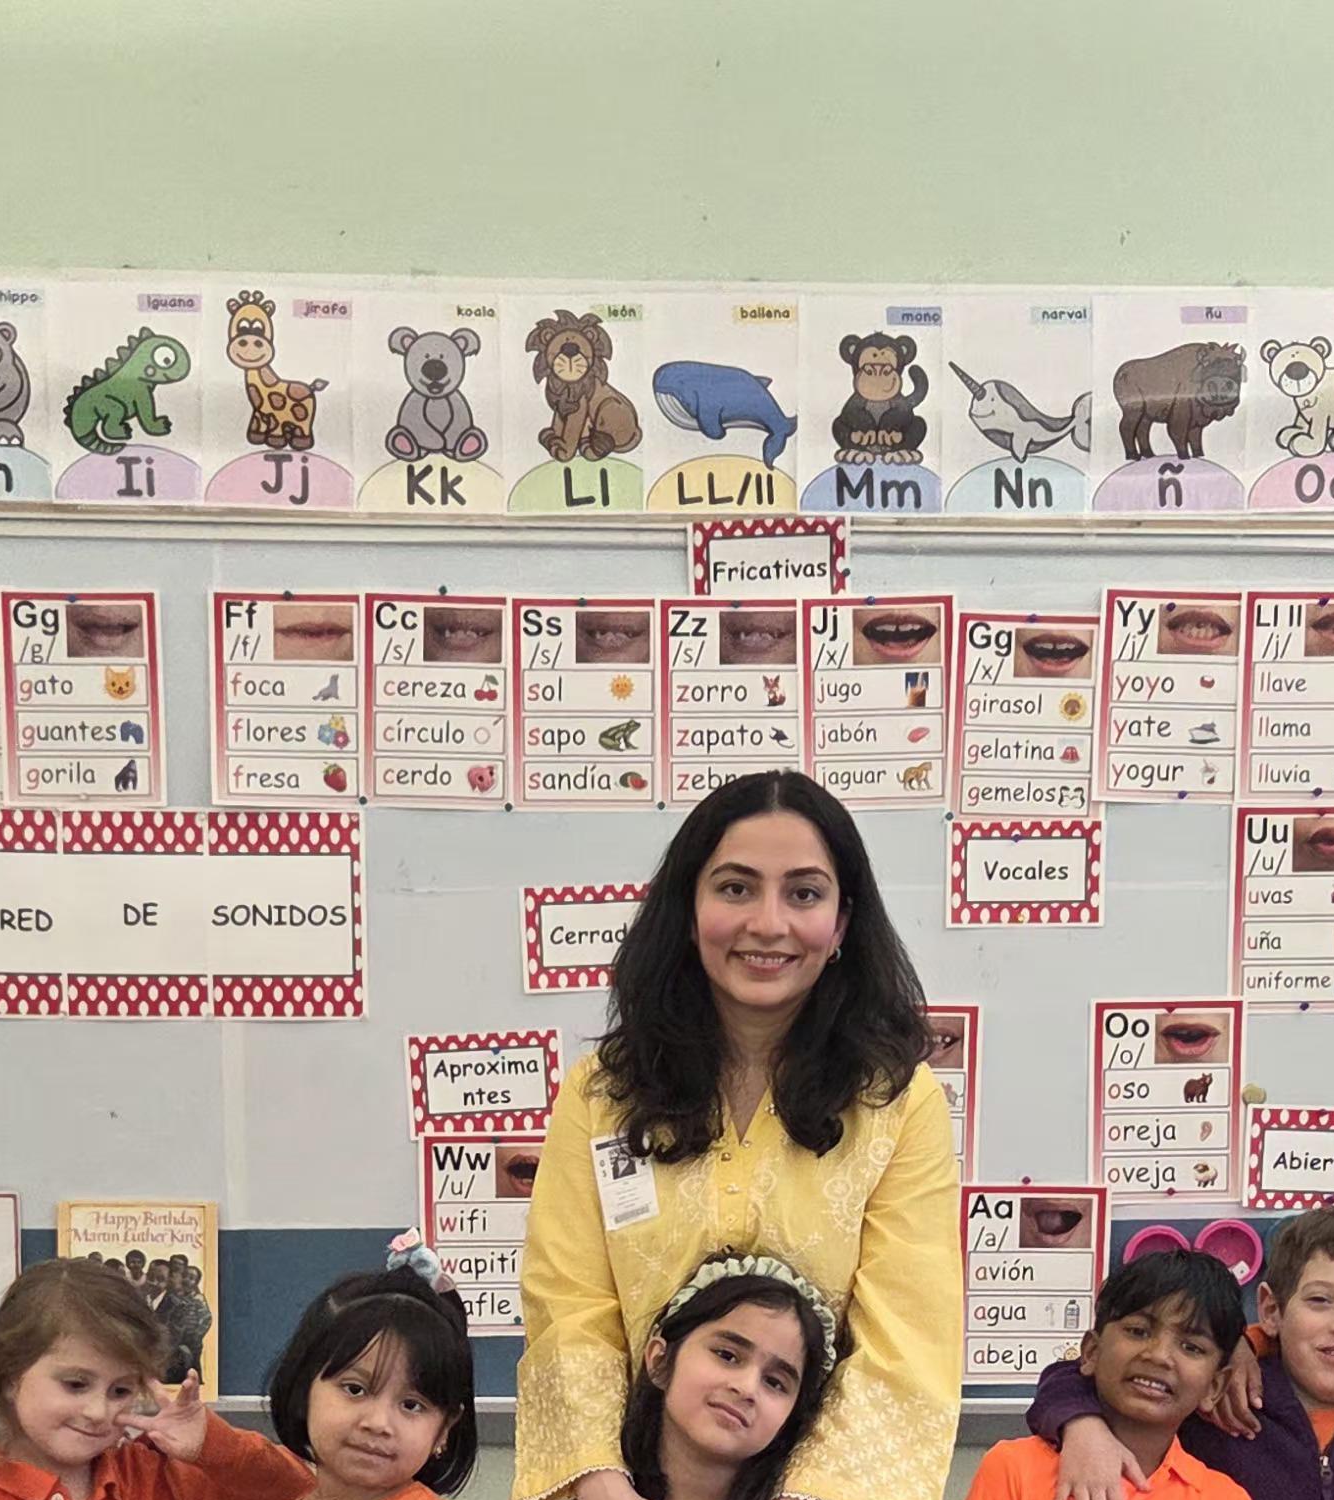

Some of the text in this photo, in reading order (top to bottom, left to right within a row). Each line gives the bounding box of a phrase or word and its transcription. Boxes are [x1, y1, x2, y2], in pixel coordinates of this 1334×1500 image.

[406, 465, 466, 506] Kk
[836, 468, 921, 508] Mm
[713, 559, 827, 583] Fricativas
[12, 600, 59, 636] Gg
[19, 674, 73, 700] gato
[231, 675, 285, 697] foca
[383, 679, 466, 699] cereza
[528, 681, 562, 702] sol
[677, 682, 747, 702] zorro
[1116, 674, 1174, 702] yoyo
[1260, 673, 1307, 693] llave
[968, 693, 1042, 720] girasol
[22, 722, 116, 747] guantes
[233, 718, 306, 742] flores
[383, 718, 464, 743] círculo
[677, 727, 763, 755] zapato
[818, 722, 877, 749] jabón
[967, 739, 1054, 765] gelatina
[26, 764, 96, 790] gorila
[383, 764, 451, 786] cerdo
[528, 766, 611, 790] sandía
[1112, 762, 1184, 788] yogur
[1259, 763, 1310, 784] lluvia
[1248, 817, 1288, 845] Uu
[984, 860, 1068, 881] Vocales
[1248, 888, 1293, 904] uvas
[124, 903, 158, 926] DE
[212, 905, 347, 927] SONIDOS
[550, 924, 626, 945] Cerrad
[1248, 930, 1281, 951] uña
[1247, 971, 1331, 991] uniforme
[434, 1058, 539, 1082] Aproxima
[463, 1088, 511, 1106] ntes
[1109, 1081, 1149, 1100] oso
[1108, 1121, 1176, 1147] oreja
[1108, 1163, 1176, 1189] oveja
[440, 1212, 487, 1233] wifi
[441, 1249, 516, 1277] wapití
[975, 1258, 1034, 1282] avión
[974, 1305, 1027, 1327] agua
[974, 1343, 1037, 1372] abeja
